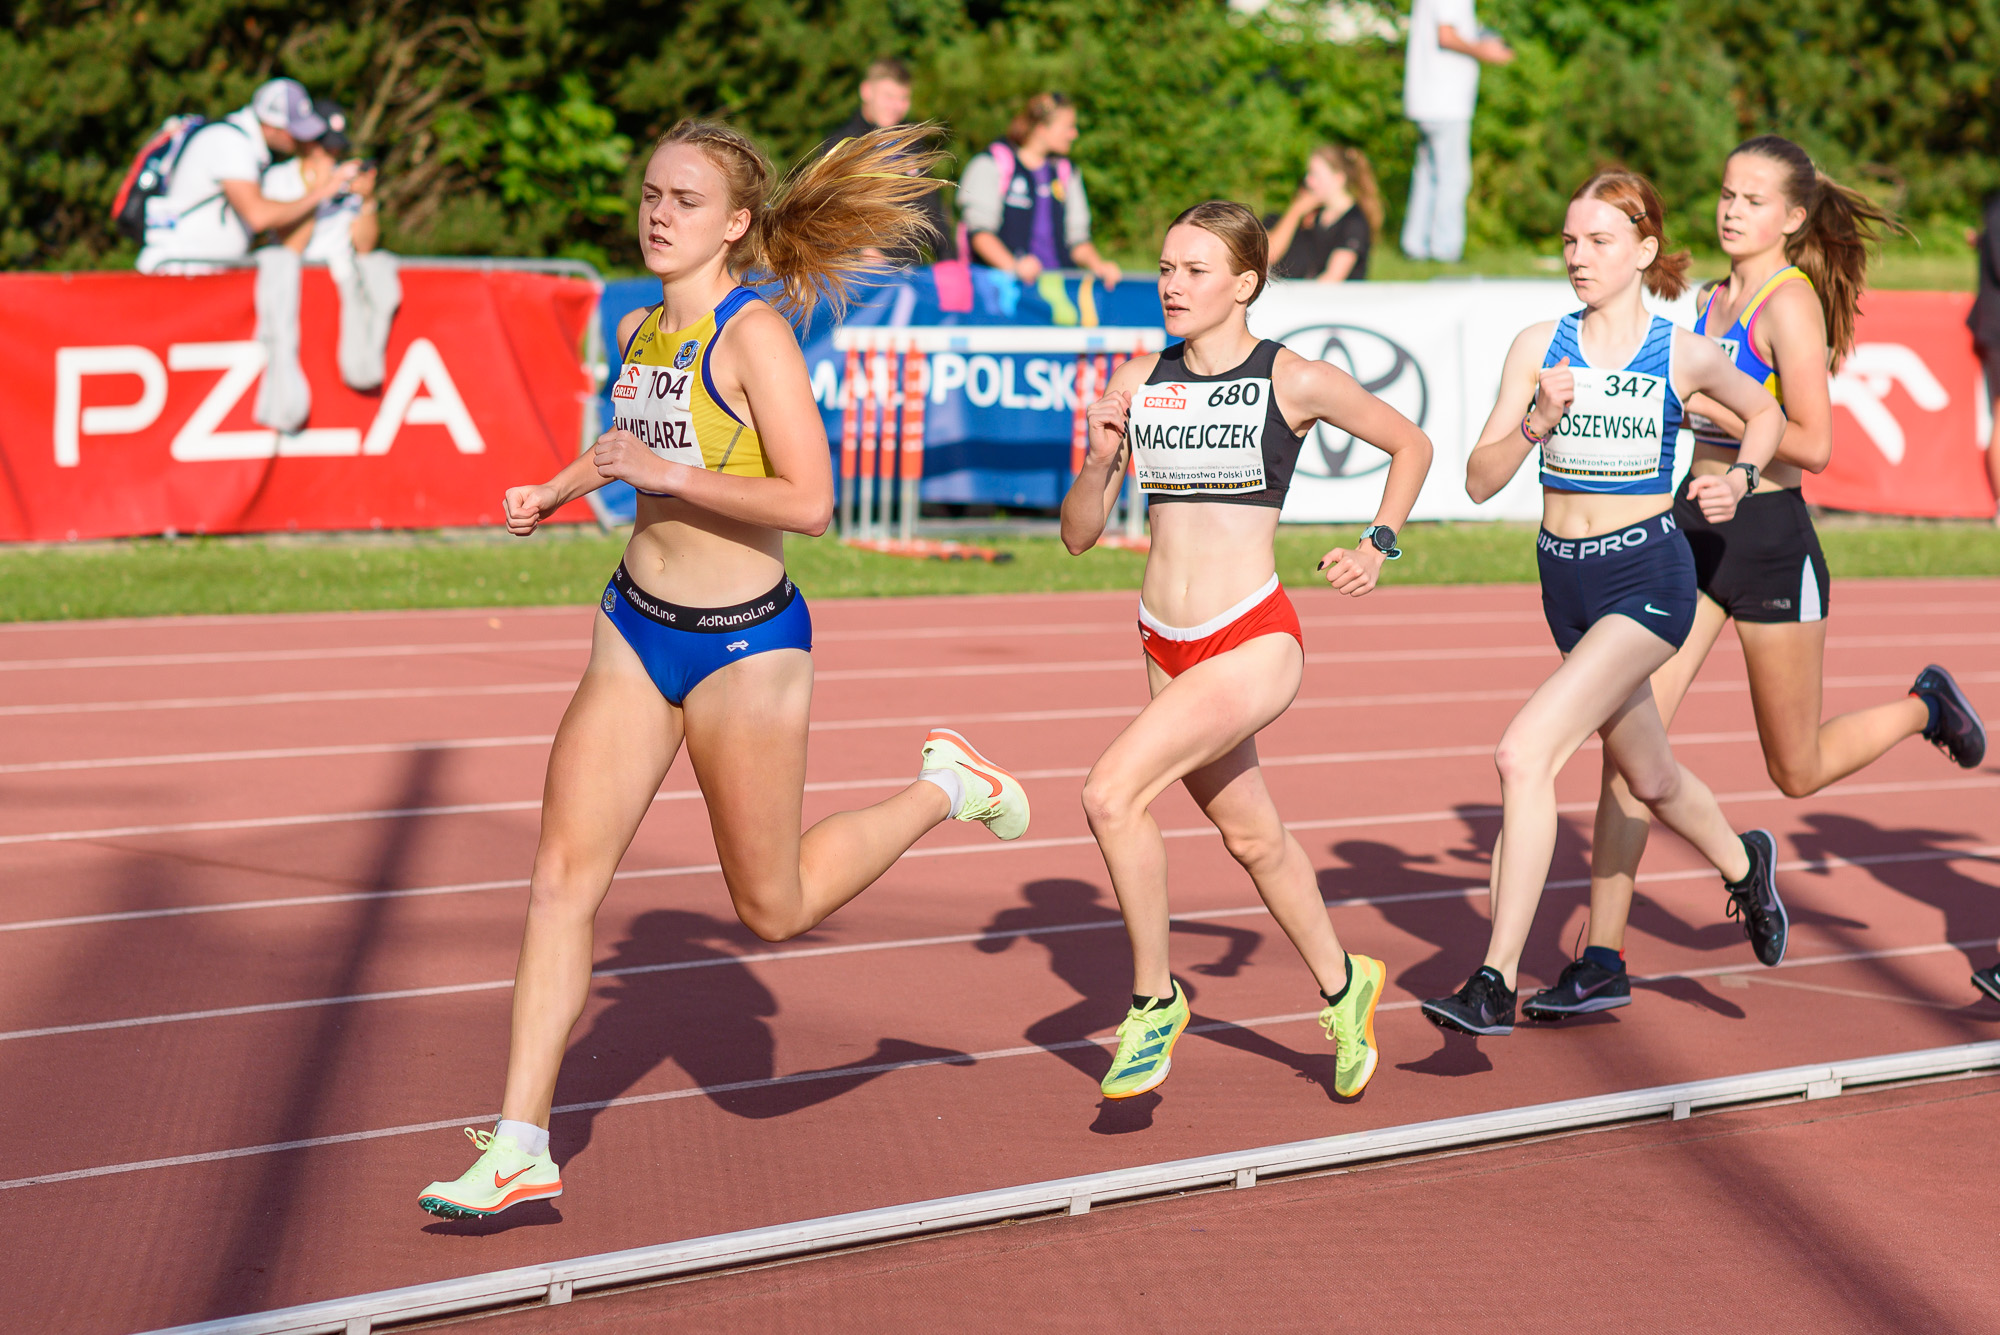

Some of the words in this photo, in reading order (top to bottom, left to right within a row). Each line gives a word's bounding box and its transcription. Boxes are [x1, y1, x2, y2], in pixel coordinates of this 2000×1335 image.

[615, 386, 637, 399] ORLEN
[1208, 382, 1260, 408] 680
[1604, 375, 1657, 398] 347
[1145, 397, 1185, 409] ORLEN
[613, 417, 692, 449] HMIELARZ
[1135, 424, 1258, 450] MACIEJCZEK
[1550, 413, 1657, 439] OSZEWSKA
[1139, 470, 1150, 479] 54.
[1152, 471, 1167, 480] PZLA
[1169, 471, 1216, 480] Mistrzostwa
[1218, 470, 1243, 479] Polski
[1245, 468, 1262, 478] U18
[1569, 457, 1615, 467] Mistrzostwa
[1618, 459, 1642, 467] Polski
[1579, 527, 1648, 560] PRO
